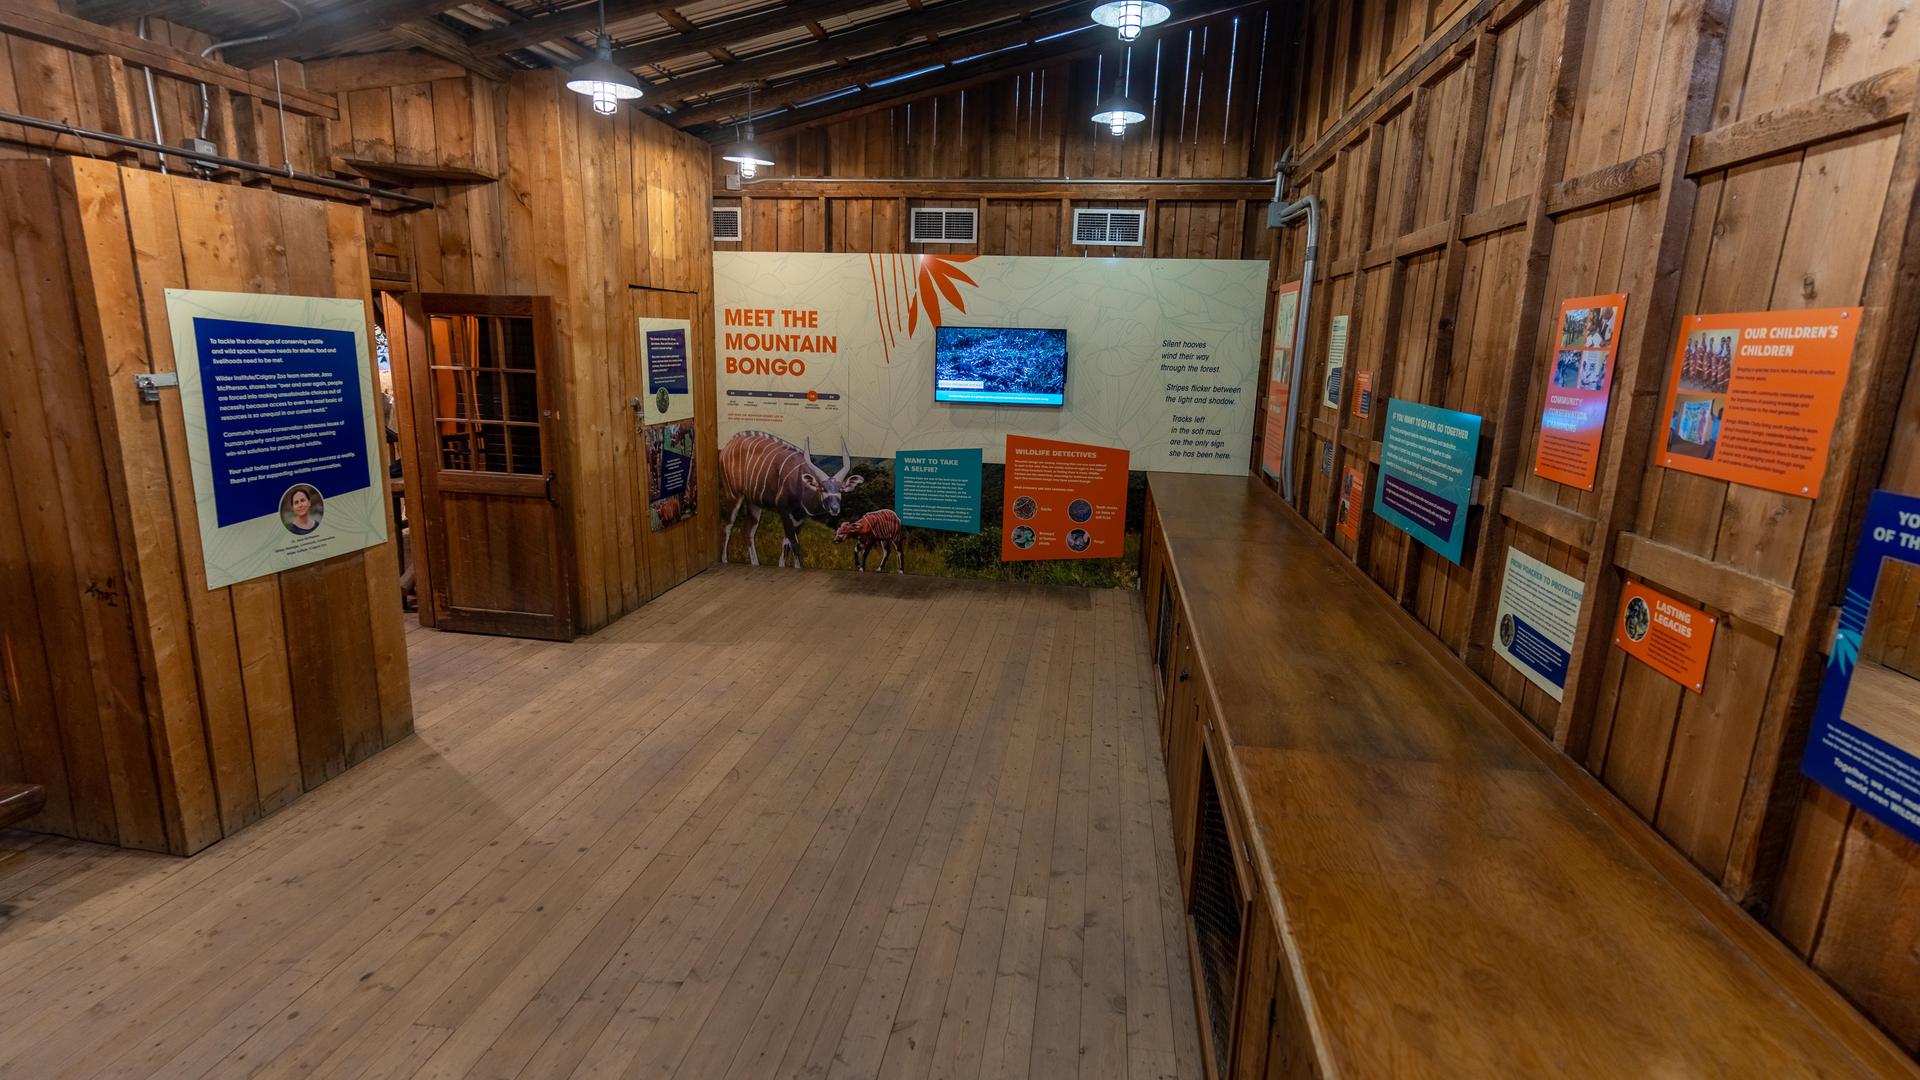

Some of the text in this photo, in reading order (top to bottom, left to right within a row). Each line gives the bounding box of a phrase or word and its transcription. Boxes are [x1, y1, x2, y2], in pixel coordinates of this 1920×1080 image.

[724, 308, 818, 328] MEET THE
[1744, 325, 1839, 339] OUR CHILDREN'S
[725, 332, 837, 353] MOUNTAIN
[1162, 340, 1206, 348] Silent hooves
[1740, 345, 1794, 357] CHILDREN
[726, 356, 805, 376] BONGO
[1160, 364, 1186, 373] through
[1166, 384, 1189, 392] Stripes
[1178, 396, 1192, 404] light
[1194, 415, 1205, 423] left
[1404, 415, 1415, 424] WANT
[1416, 418, 1421, 426] TO
[1421, 419, 1428, 428] GO
[1437, 423, 1444, 433] GO
[1444, 425, 1469, 439] TOGETHER
[1211, 440, 1224, 448] sign
[1052, 450, 1097, 458] DETECTIVES
[1215, 451, 1231, 459] here.
[1873, 526, 1896, 543] OF
[1543, 576, 1550, 585] TO
[1656, 600, 1692, 624] LASTING
[1654, 612, 1692, 638] LEGACIES
[1834, 756, 1869, 784] Together,
[1870, 779, 1884, 791] we
[1884, 788, 1902, 802] can
[1844, 777, 1868, 795] world
[1868, 790, 1889, 807] even
